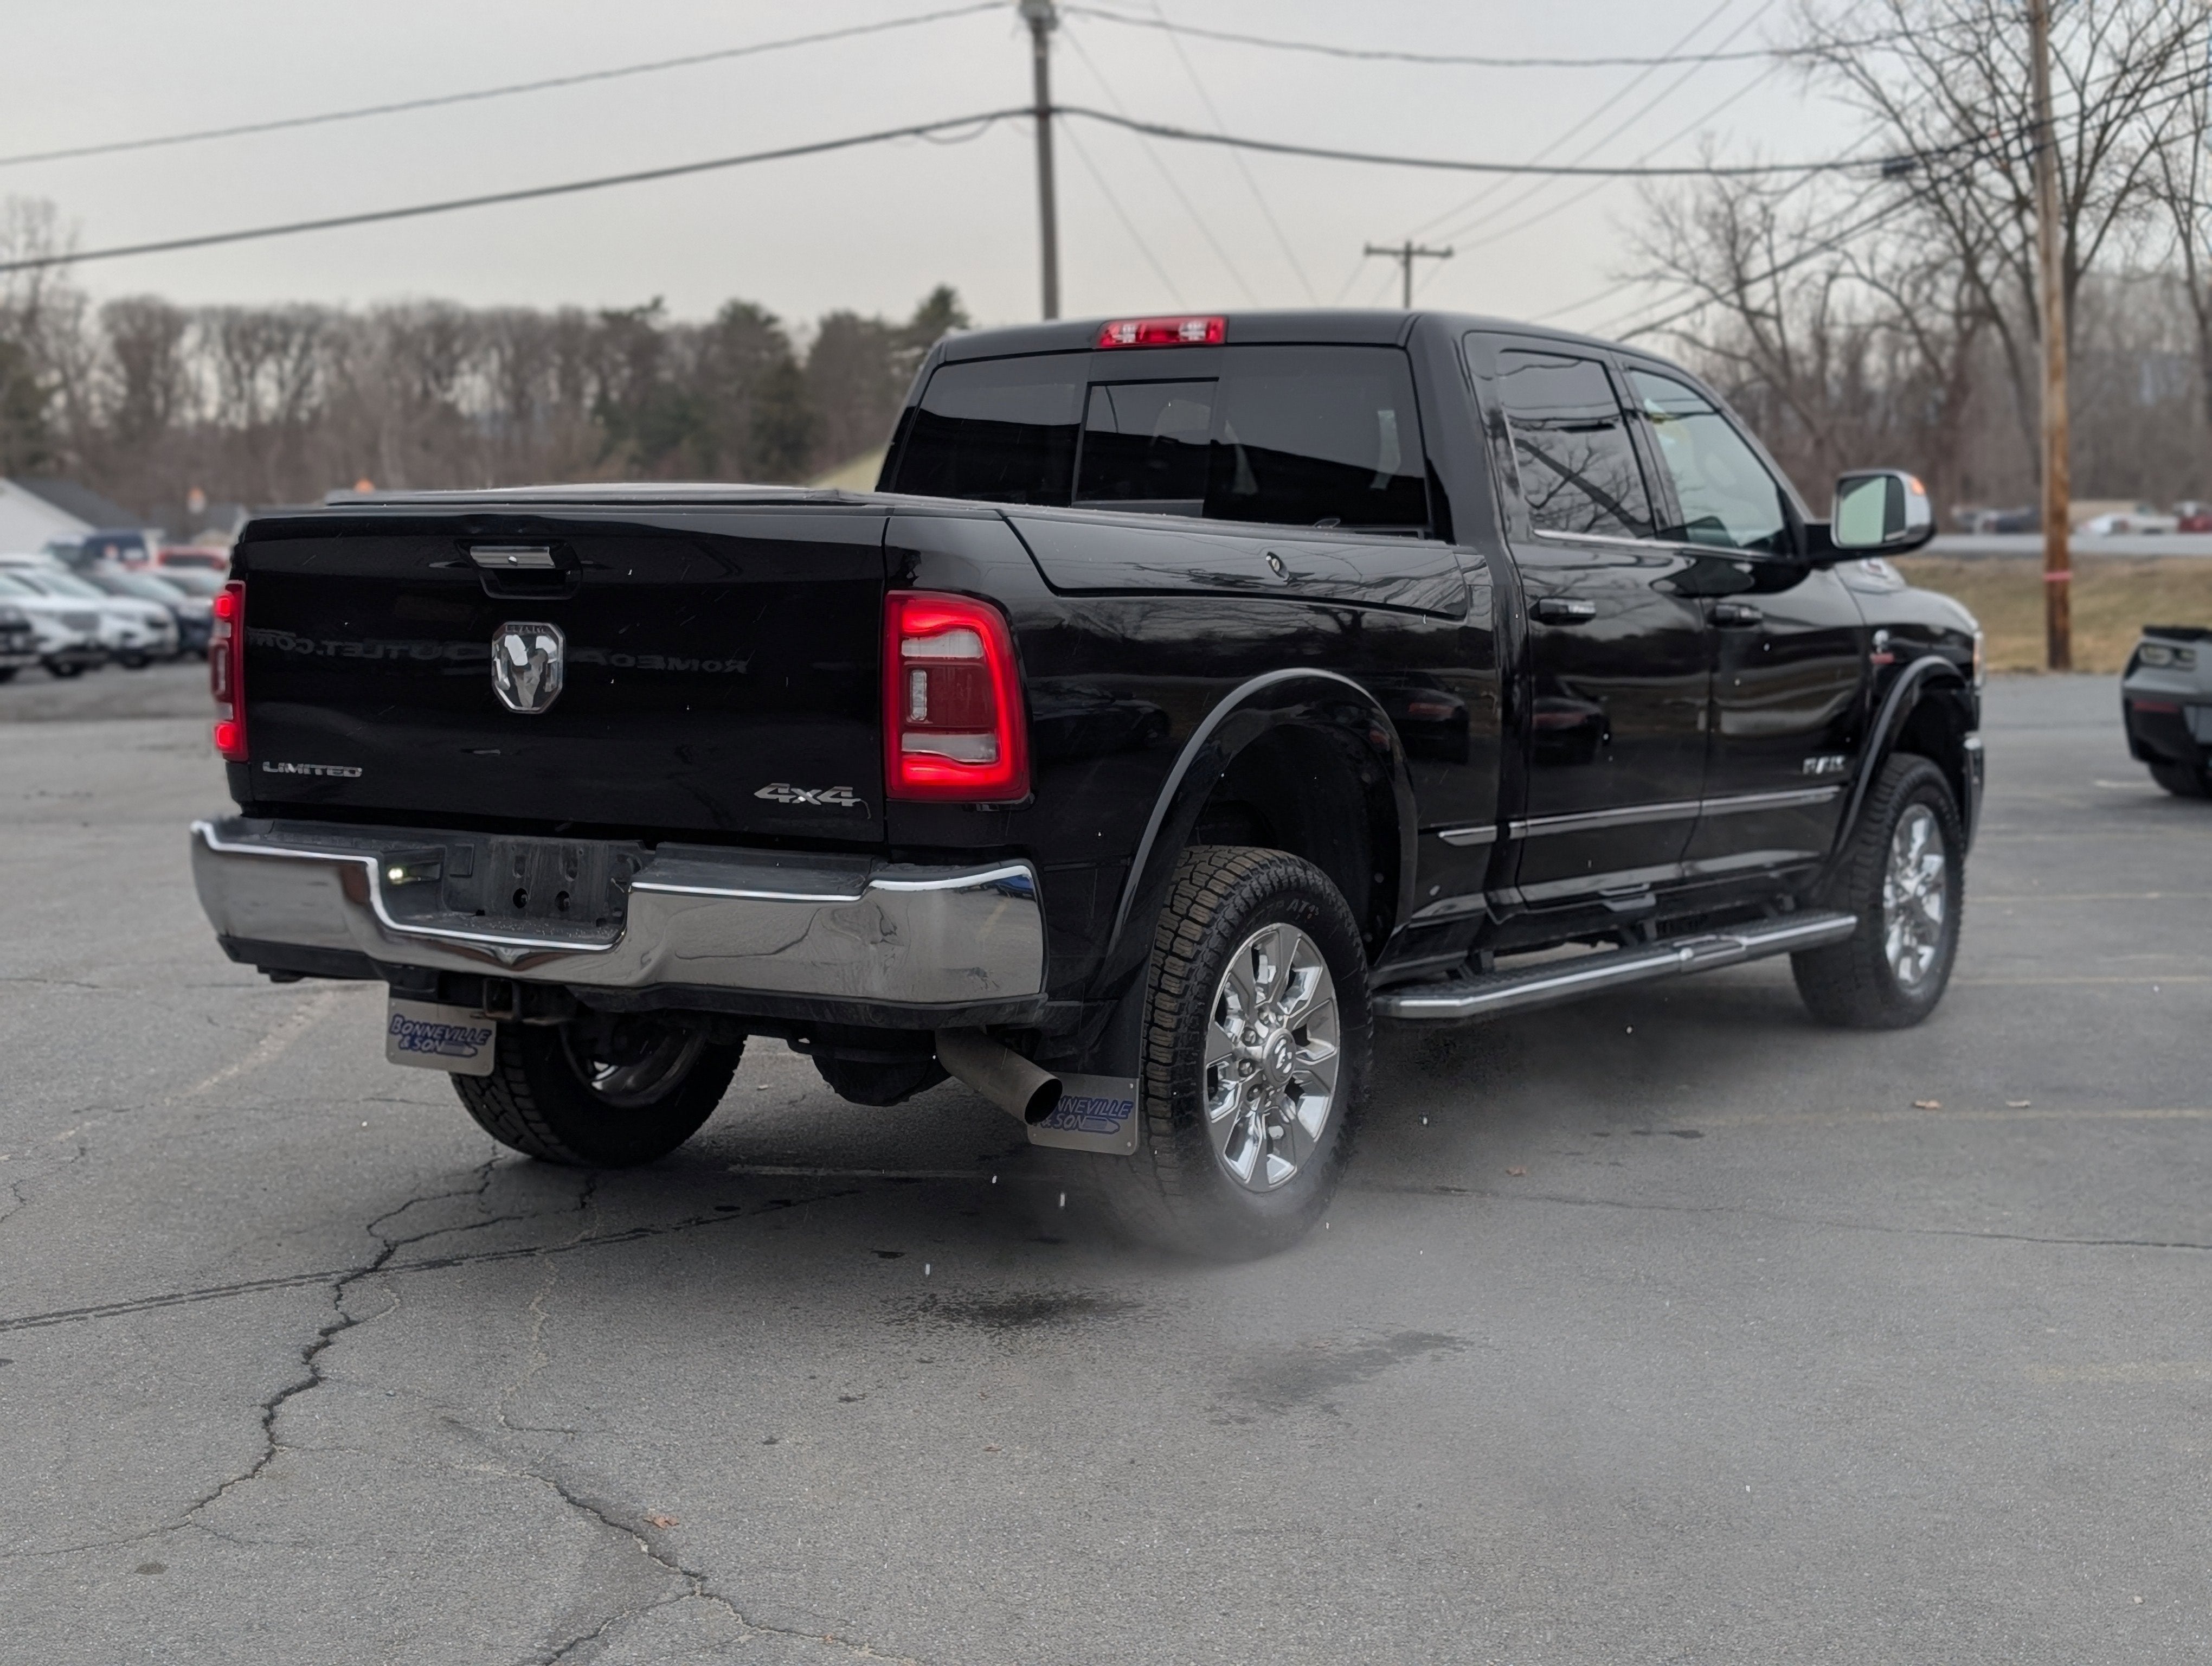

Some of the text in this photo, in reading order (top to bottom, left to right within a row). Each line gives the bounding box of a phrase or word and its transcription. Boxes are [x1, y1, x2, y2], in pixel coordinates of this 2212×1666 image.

[263, 761, 362, 777] LIMITED
[412, 1036, 445, 1053] SON
[1057, 1095, 1134, 1119] NNEVILLE
[1053, 1112, 1086, 1131] SON
